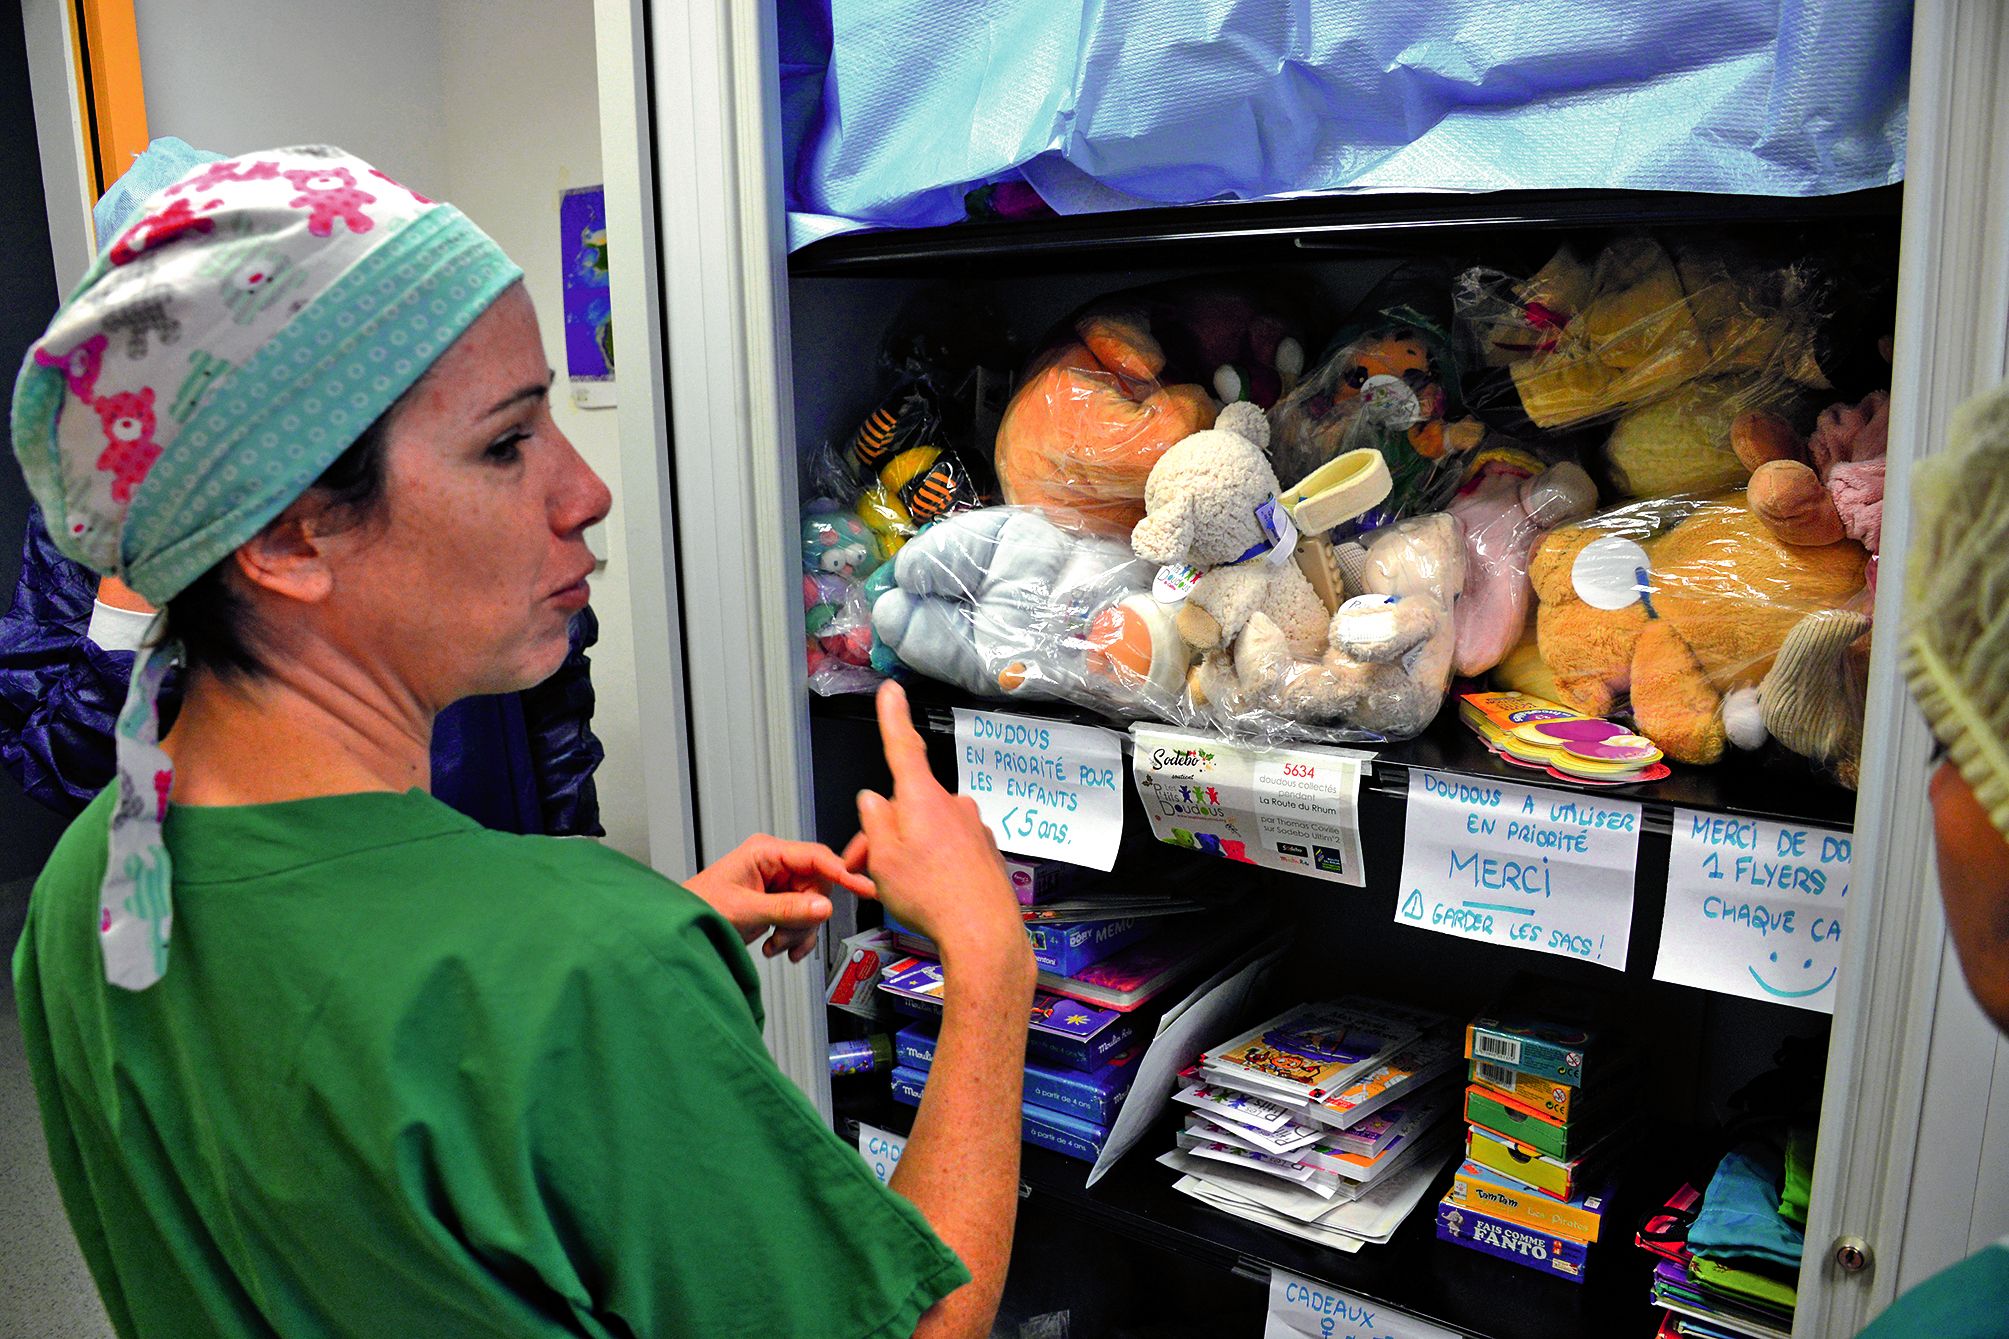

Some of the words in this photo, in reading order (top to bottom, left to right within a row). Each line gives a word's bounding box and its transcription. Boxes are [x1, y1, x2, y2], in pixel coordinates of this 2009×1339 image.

[974, 716, 1050, 750] DOUDOUS
[966, 746, 985, 765] EN
[994, 750, 1067, 782] PRIORITÉ
[1079, 764, 1116, 792] POUR
[1152, 748, 1200, 771] Sodebo
[1283, 762, 1315, 779] 5634
[970, 771, 993, 792] LES
[1007, 778, 1079, 812] ENFANTS
[1259, 774, 1297, 788] doudous
[1298, 780, 1337, 794] collectés
[1278, 789, 1316, 801] pendant
[1160, 800, 1225, 818] Doudous
[1259, 796, 1270, 805] La
[1271, 797, 1297, 809] Route
[1298, 801, 1310, 811] du
[1311, 803, 1337, 815] Rhum
[1425, 773, 1503, 807] DOUDOUS
[1550, 802, 1634, 832] UTILISER
[1260, 815, 1275, 824] par
[1277, 817, 1310, 830] Thomas
[1311, 823, 1340, 835] Coville
[1263, 825, 1275, 833] sur
[1276, 826, 1310, 839] Sodebo
[1467, 813, 1496, 834] EN
[1508, 821, 1589, 853] PRIORITÉ
[1691, 815, 1757, 850] MERCI
[1777, 829, 1808, 858] DE
[1449, 849, 1551, 898] MERCI
[1702, 851, 1723, 880] 1
[1736, 856, 1828, 895] FLYERS
[1432, 903, 1494, 935] GARDER
[1509, 922, 1542, 941] LES
[1703, 896, 1796, 937] CHAQUE
[1041, 1089, 1060, 1101] partir
[1061, 1095, 1072, 1104] de
[1078, 1101, 1091, 1110] ans
[868, 1137, 903, 1162] CAD
[1037, 1131, 1055, 1142] partir
[1056, 1135, 1067, 1144] de
[1074, 1142, 1087, 1151] ans
[1476, 1220, 1502, 1235] FAIS
[1504, 1229, 1546, 1249] COMME
[1551, 1213, 1590, 1233] Pirates
[1472, 1226, 1548, 1260] FANTO
[1286, 1282, 1375, 1329] CADEAUX
